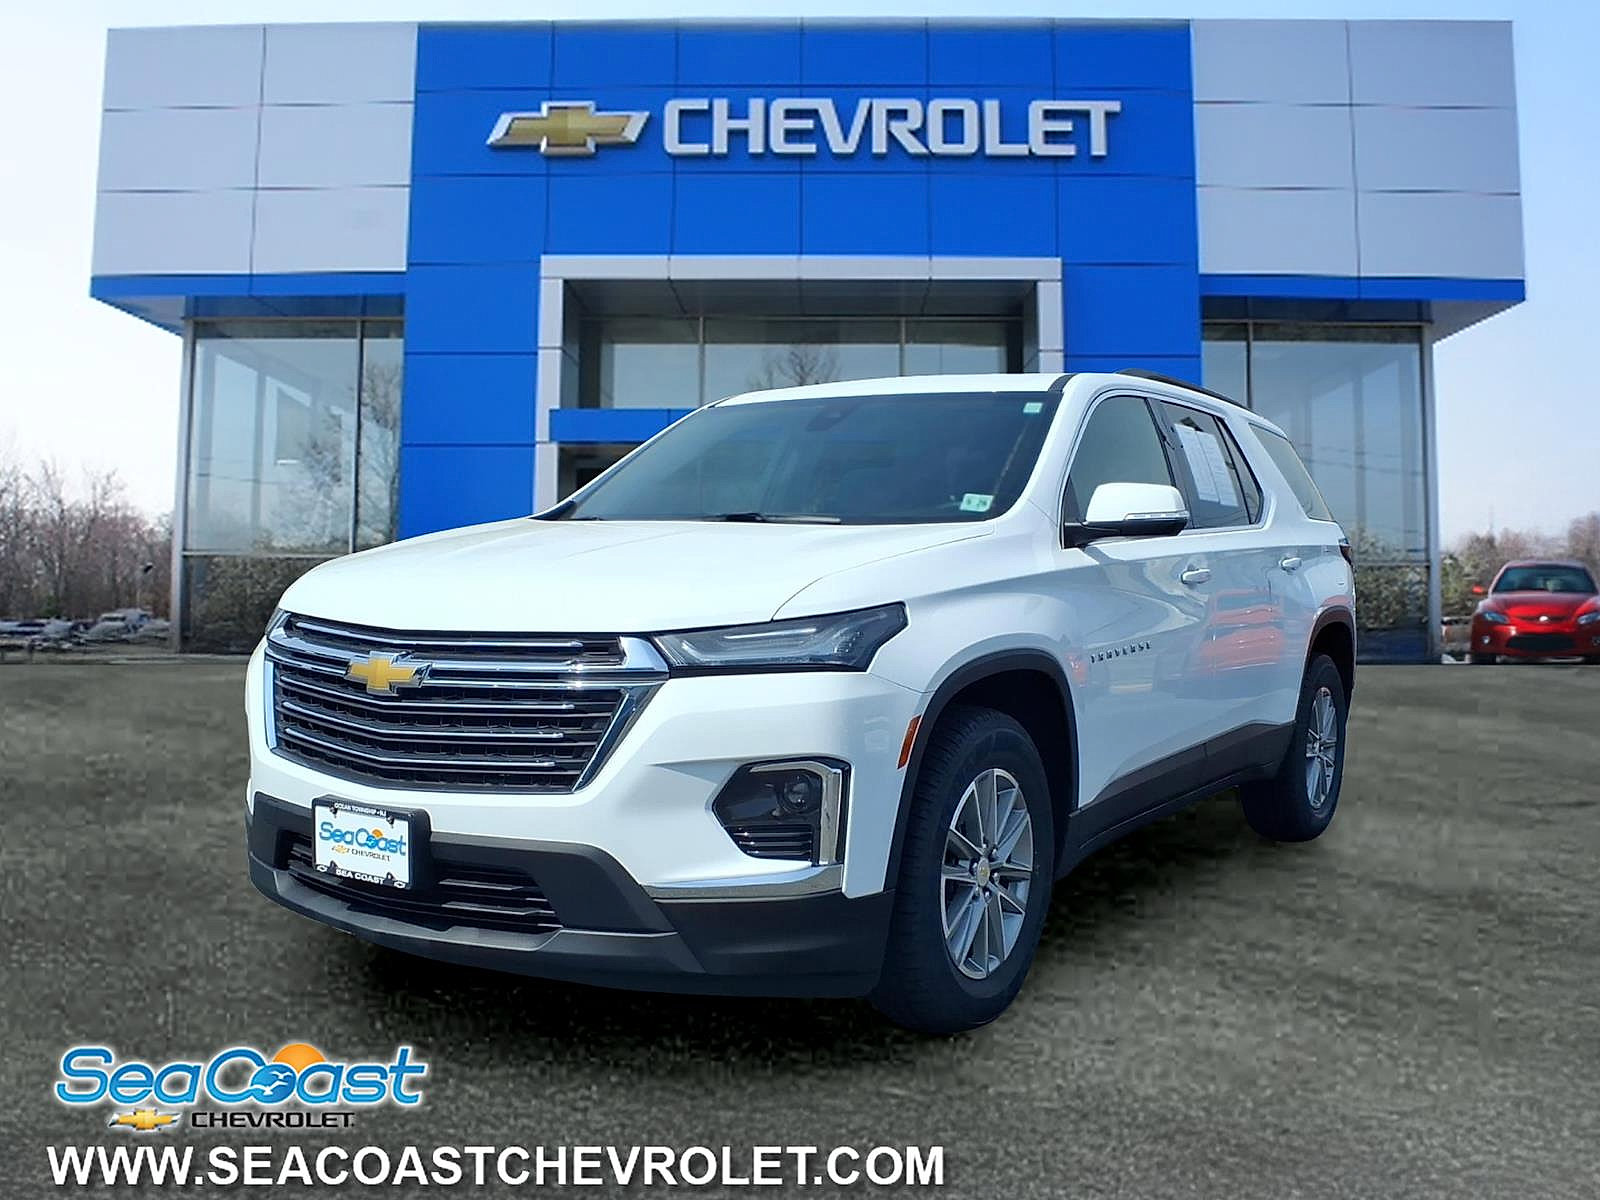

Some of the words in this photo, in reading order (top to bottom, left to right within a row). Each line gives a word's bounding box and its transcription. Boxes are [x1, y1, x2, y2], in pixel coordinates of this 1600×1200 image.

[663, 97, 1122, 158] CHEVROLET
[351, 848, 392, 862] CHEVROLET
[335, 868, 354, 879] SEA
[354, 872, 384, 885] COAST
